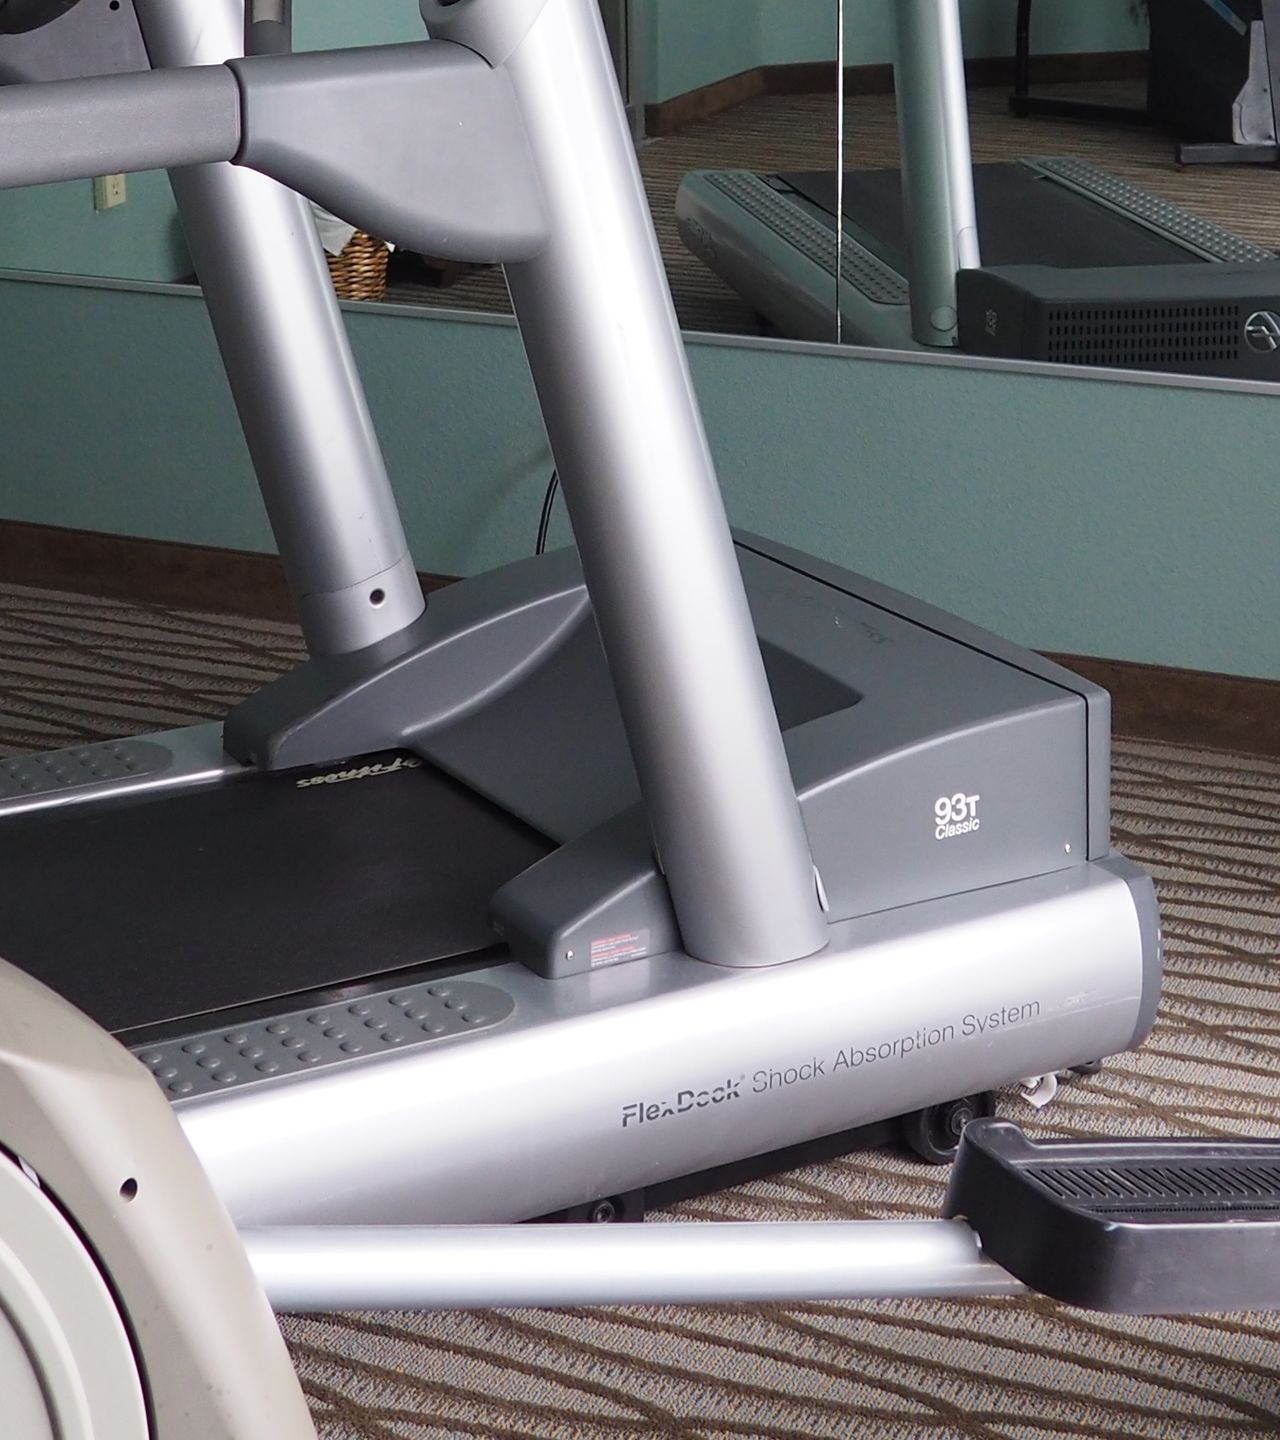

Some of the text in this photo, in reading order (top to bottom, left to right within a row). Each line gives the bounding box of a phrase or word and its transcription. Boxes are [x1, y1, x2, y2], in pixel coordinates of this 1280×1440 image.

[935, 793, 980, 825] 93T
[935, 817, 980, 840] Classic
[752, 1056, 825, 1093] Shock
[832, 1027, 955, 1072] Absorption
[961, 1001, 1041, 1037] System
